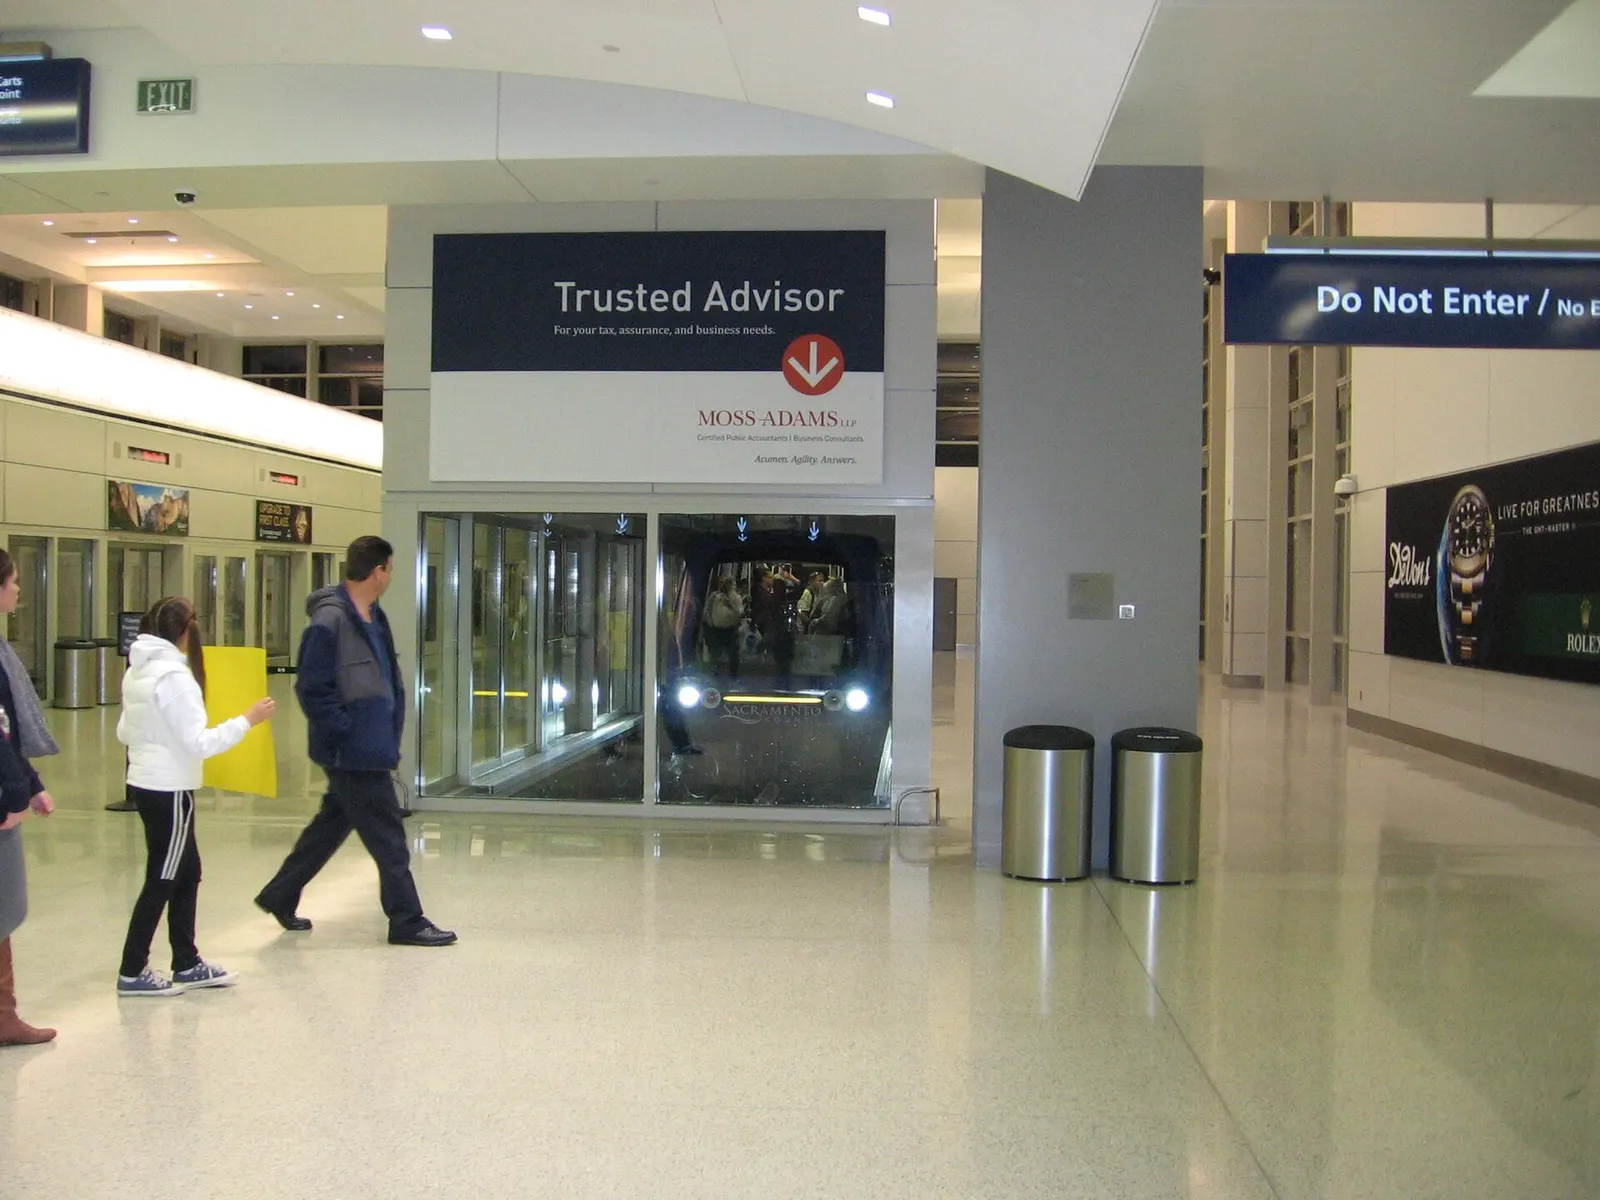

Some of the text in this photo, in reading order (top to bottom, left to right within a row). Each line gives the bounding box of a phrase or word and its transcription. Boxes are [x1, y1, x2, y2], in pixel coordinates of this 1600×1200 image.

[147, 82, 187, 109] EXIT
[553, 280, 845, 313] Trusted Advisor
[1316, 285, 1362, 313] Do
[1373, 286, 1433, 315] Not
[1443, 287, 1531, 316] Enter
[1557, 299, 1585, 317] No
[553, 324, 776, 337] For your tax, assurance, and business needs.
[698, 410, 756, 427] MOSS
[758, 409, 838, 427] ADAMS
[697, 433, 725, 442] Certified
[725, 433, 746, 442] Public
[747, 433, 788, 442] Accountants
[793, 434, 823, 442] Business
[824, 434, 865, 443] Consultants
[820, 455, 858, 465] Answers.
[1498, 503, 1518, 520] LIVE
[1520, 500, 1541, 518] FOR
[1522, 526, 1533, 536] THE
[724, 703, 822, 717] SACRAMENTO
